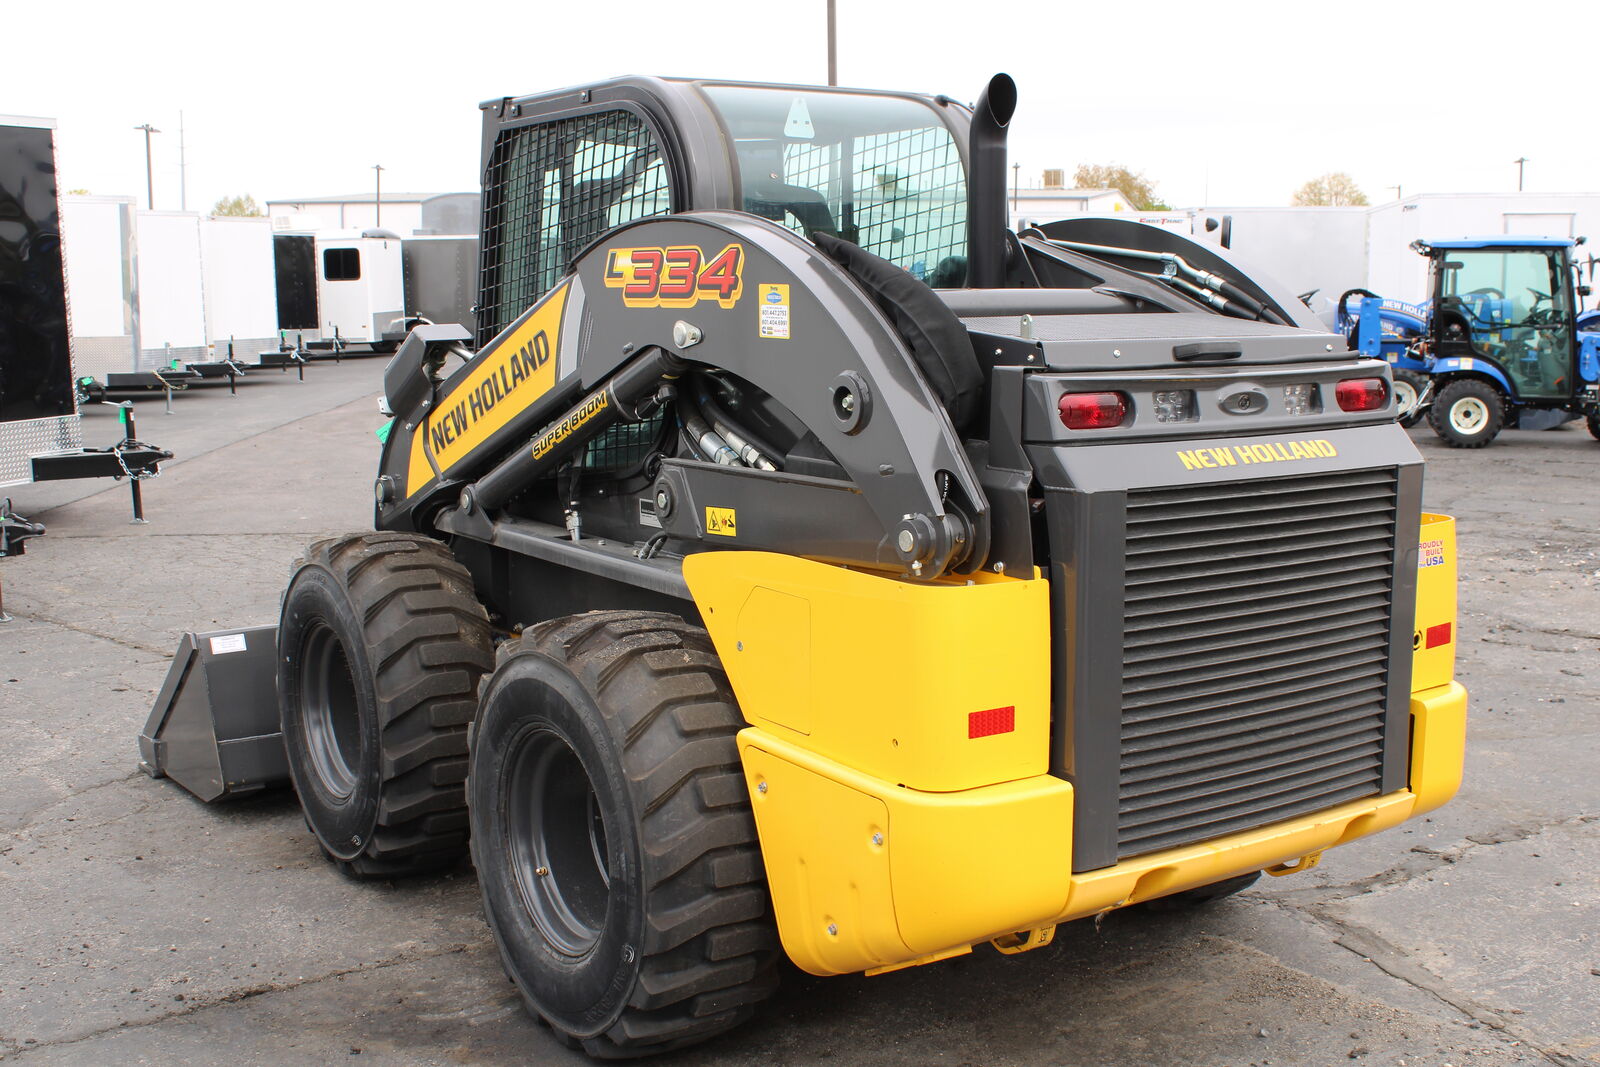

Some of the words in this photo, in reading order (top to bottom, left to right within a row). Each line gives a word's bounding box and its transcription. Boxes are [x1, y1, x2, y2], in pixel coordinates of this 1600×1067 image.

[605, 244, 743, 306] L334
[1383, 299, 1402, 310] NEW
[1402, 302, 1427, 319] HOLLA
[431, 400, 468, 455] NEW
[468, 329, 550, 423] HOLLAND
[532, 419, 571, 459] SUPER
[570, 391, 608, 430] BOOM
[1176, 447, 1238, 471] NEW
[1234, 439, 1338, 465] HOLLAND
[1419, 540, 1443, 549] ROUDLY
[1426, 548, 1443, 556] BUILT
[1426, 556, 1444, 567] USA
